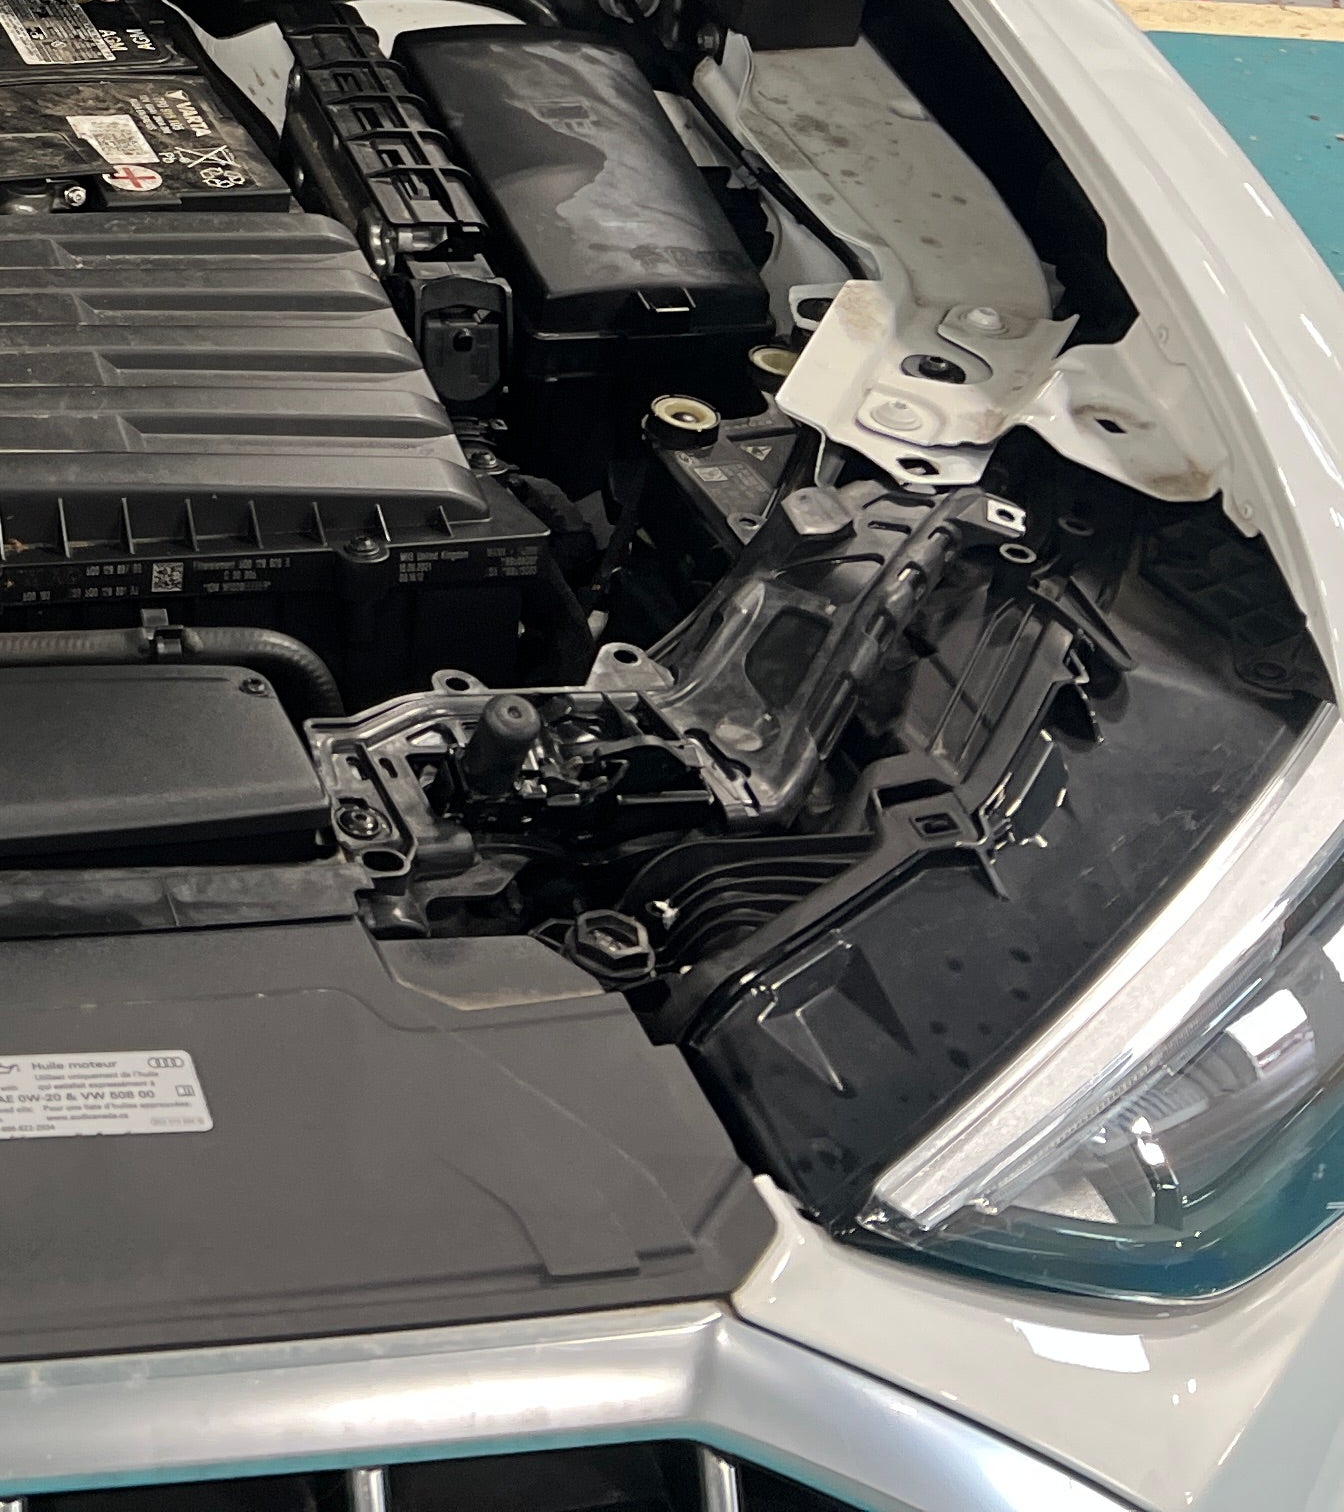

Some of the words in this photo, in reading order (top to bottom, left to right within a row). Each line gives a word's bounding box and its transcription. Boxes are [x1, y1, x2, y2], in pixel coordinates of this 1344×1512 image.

[176, 101, 212, 137] VARTA
[31, 1061, 64, 1070] Huile
[68, 1061, 117, 1070] moteur
[66, 1092, 77, 1101] &
[80, 1091, 105, 1100] VW
[138, 1090, 156, 1099] 00
